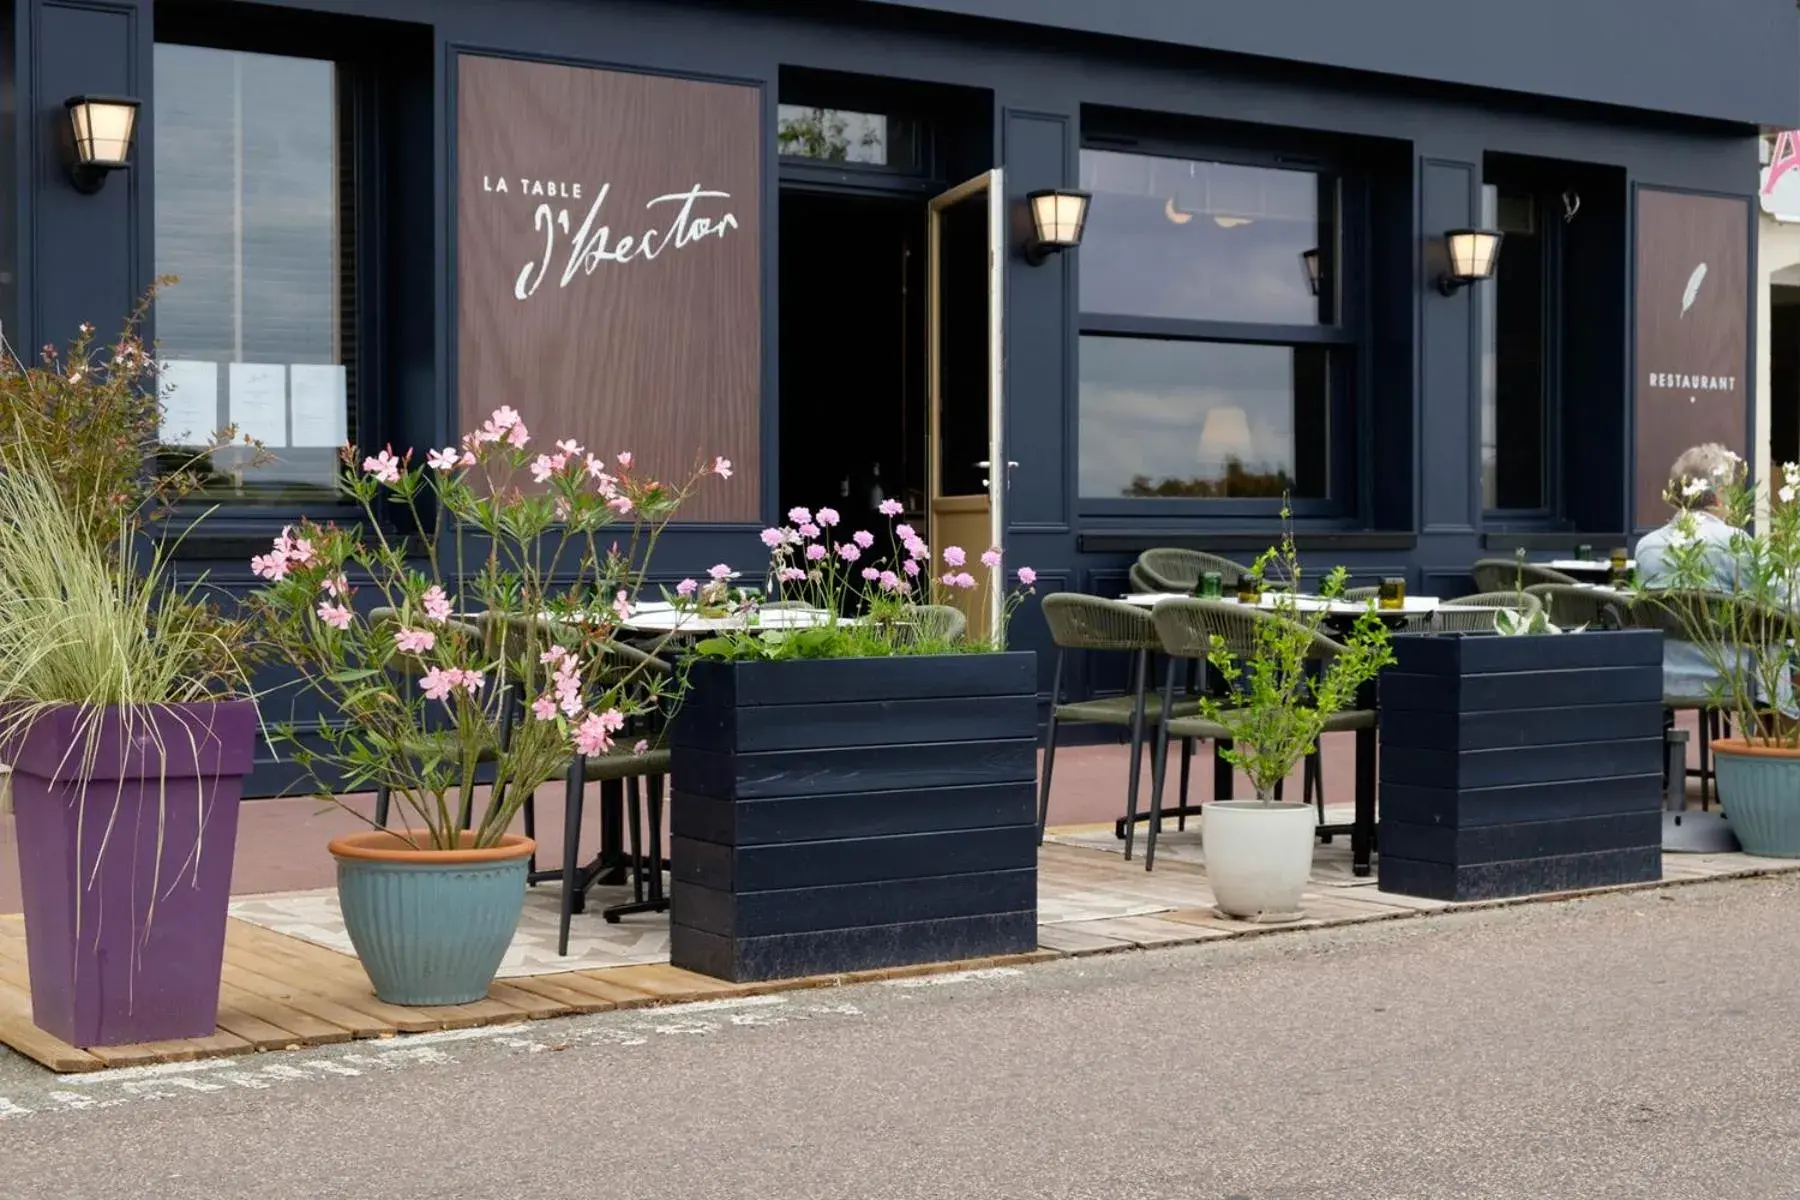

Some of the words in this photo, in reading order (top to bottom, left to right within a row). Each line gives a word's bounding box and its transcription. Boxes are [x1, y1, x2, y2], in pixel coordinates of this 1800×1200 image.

[483, 175, 508, 192] LA
[520, 178, 582, 199] TABLE
[1649, 372, 1735, 391] RESTAURANT
